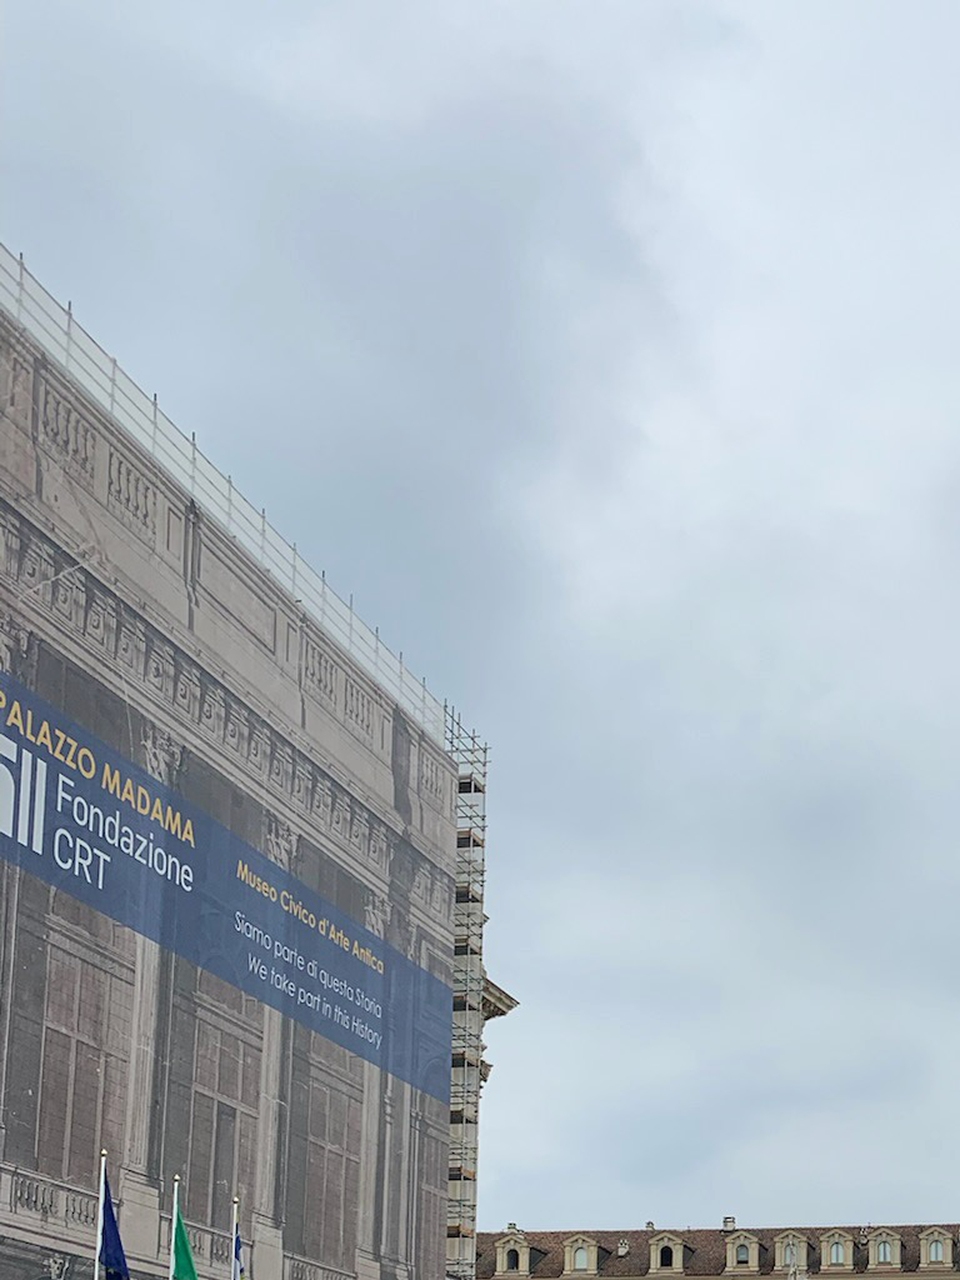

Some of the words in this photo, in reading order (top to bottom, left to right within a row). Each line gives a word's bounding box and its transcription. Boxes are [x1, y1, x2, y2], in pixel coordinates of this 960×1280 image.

[56, 772, 194, 892] Fondazione
[101, 762, 196, 849] MADAMA
[53, 827, 112, 891] CRT
[234, 910, 272, 951] Siamo
[273, 940, 305, 972] parte
[306, 958, 318, 975] di
[319, 969, 354, 1002] questa
[355, 987, 383, 1020] Storia
[236, 859, 278, 902] Museo
[280, 890, 316, 929] Civico
[318, 918, 350, 952] d'Arte
[352, 940, 385, 975] Antica
[247, 952, 268, 981] We
[270, 966, 296, 998] take
[297, 986, 321, 1013] part
[321, 996, 333, 1021] in
[333, 1003, 350, 1031] this
[351, 1014, 383, 1050] History
